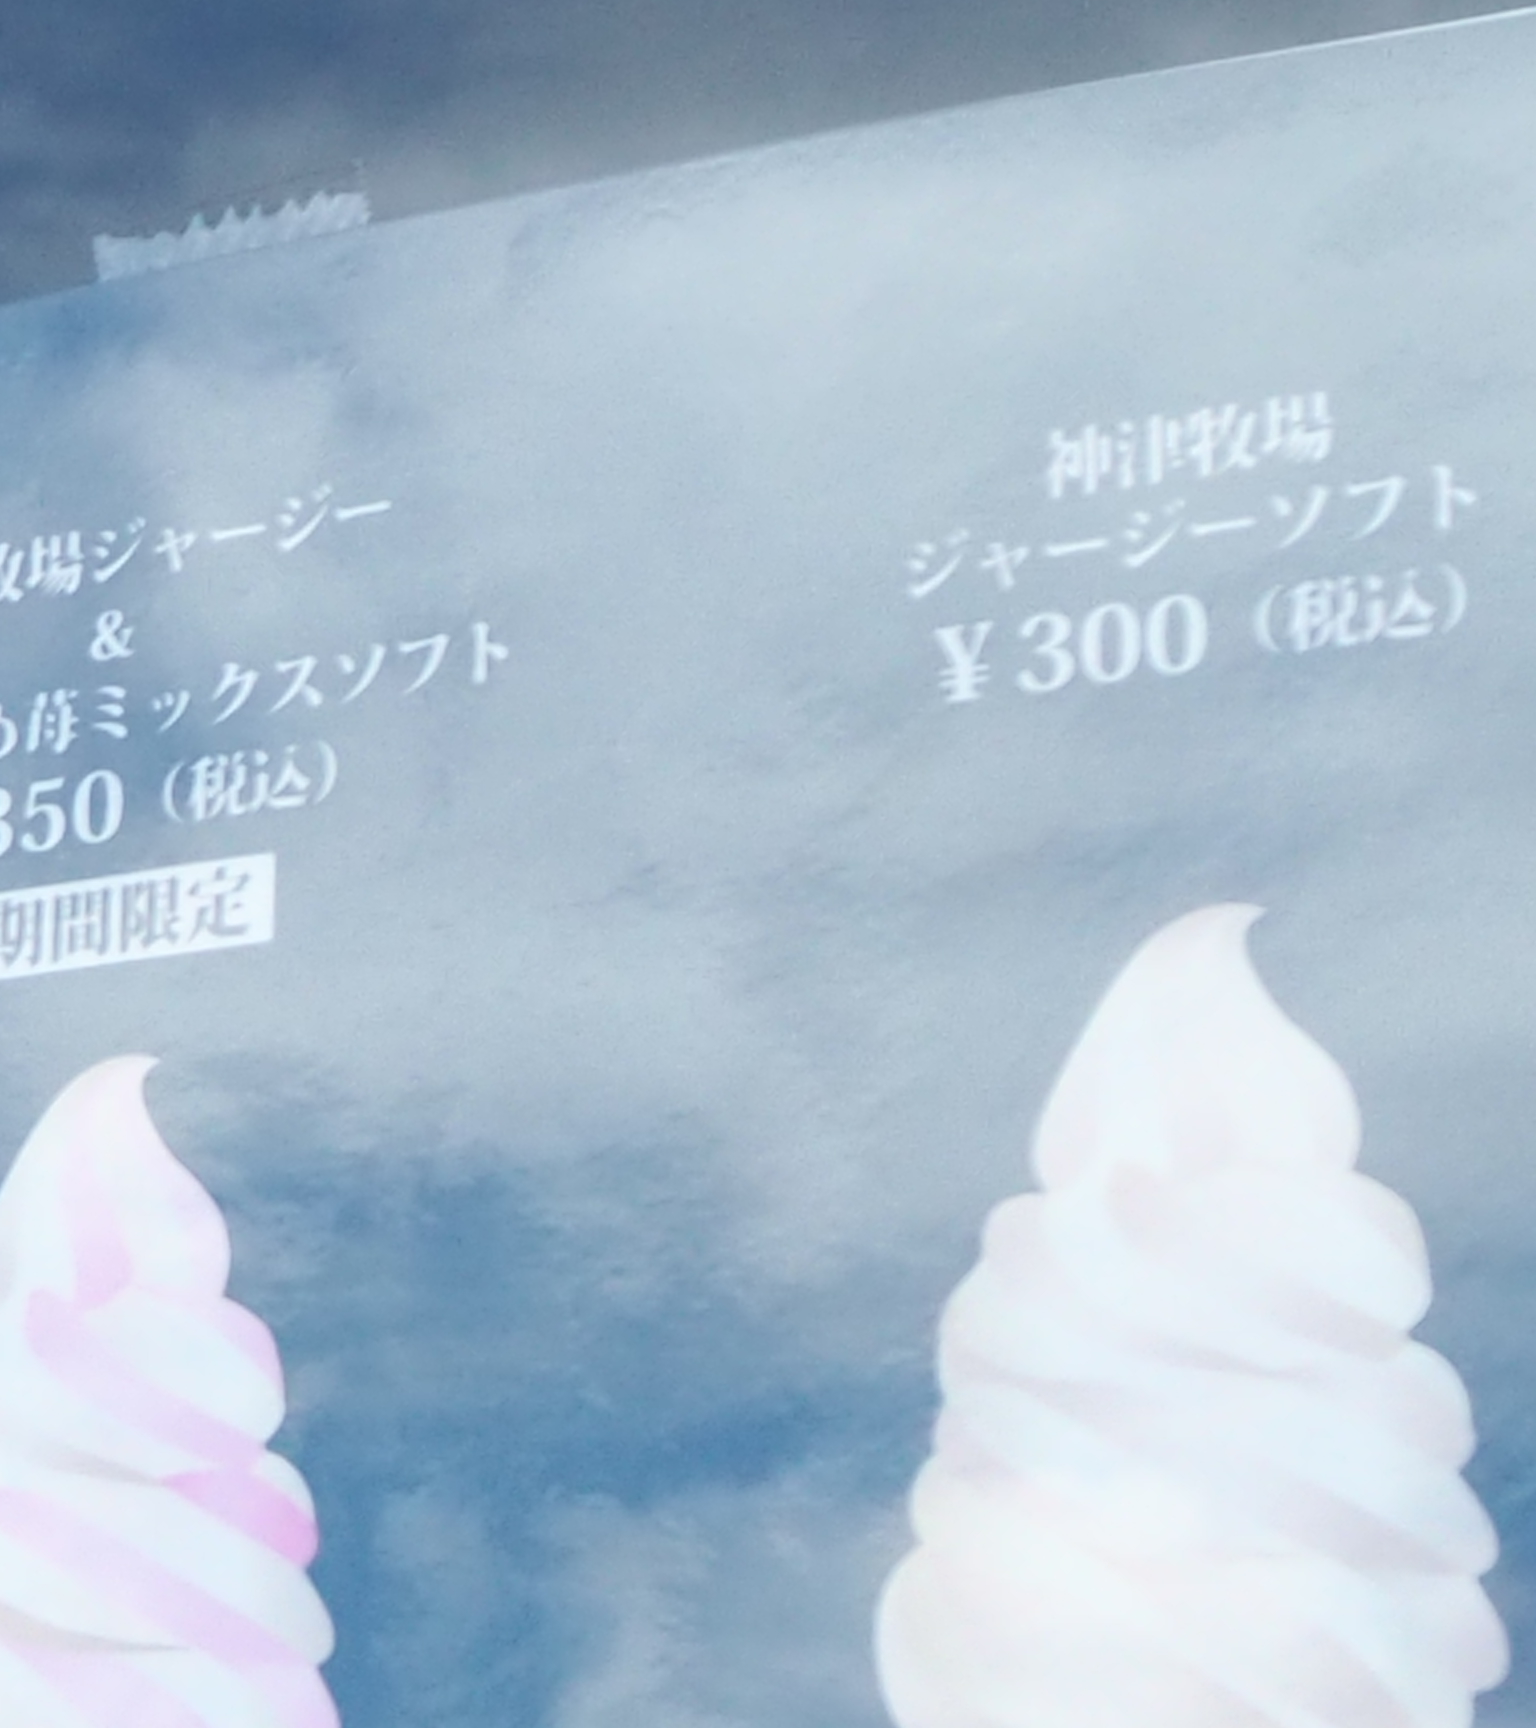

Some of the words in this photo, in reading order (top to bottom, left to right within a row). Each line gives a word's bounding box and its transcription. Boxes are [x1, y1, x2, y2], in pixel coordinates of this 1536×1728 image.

[1046, 390, 1333, 498] 神津牧場
[905, 463, 1476, 598] ジャージーソフト
[89, 610, 135, 662] &
